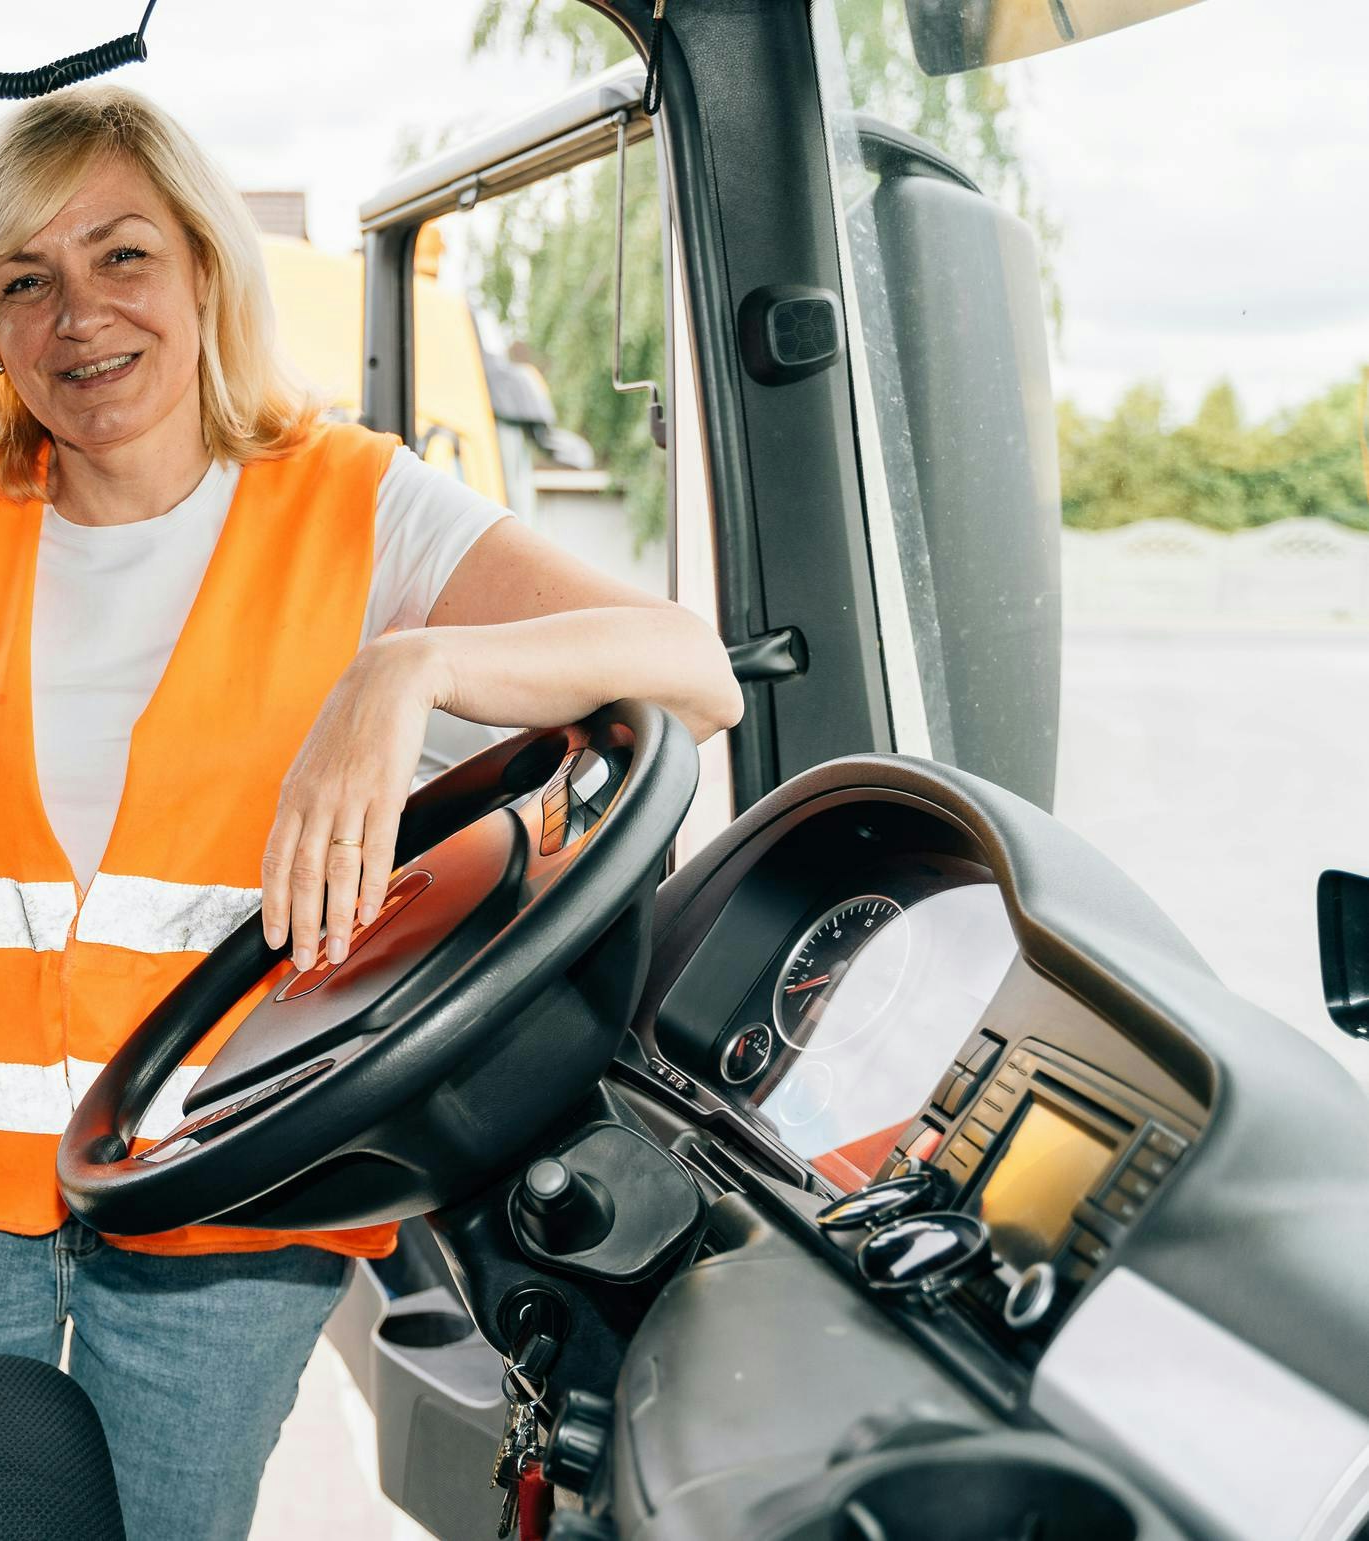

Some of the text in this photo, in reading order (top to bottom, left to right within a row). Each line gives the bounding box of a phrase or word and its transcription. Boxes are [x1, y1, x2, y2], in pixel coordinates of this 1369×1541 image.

[864, 918, 874, 928] 15
[833, 929, 843, 939] 10
[806, 959, 814, 967] 5
